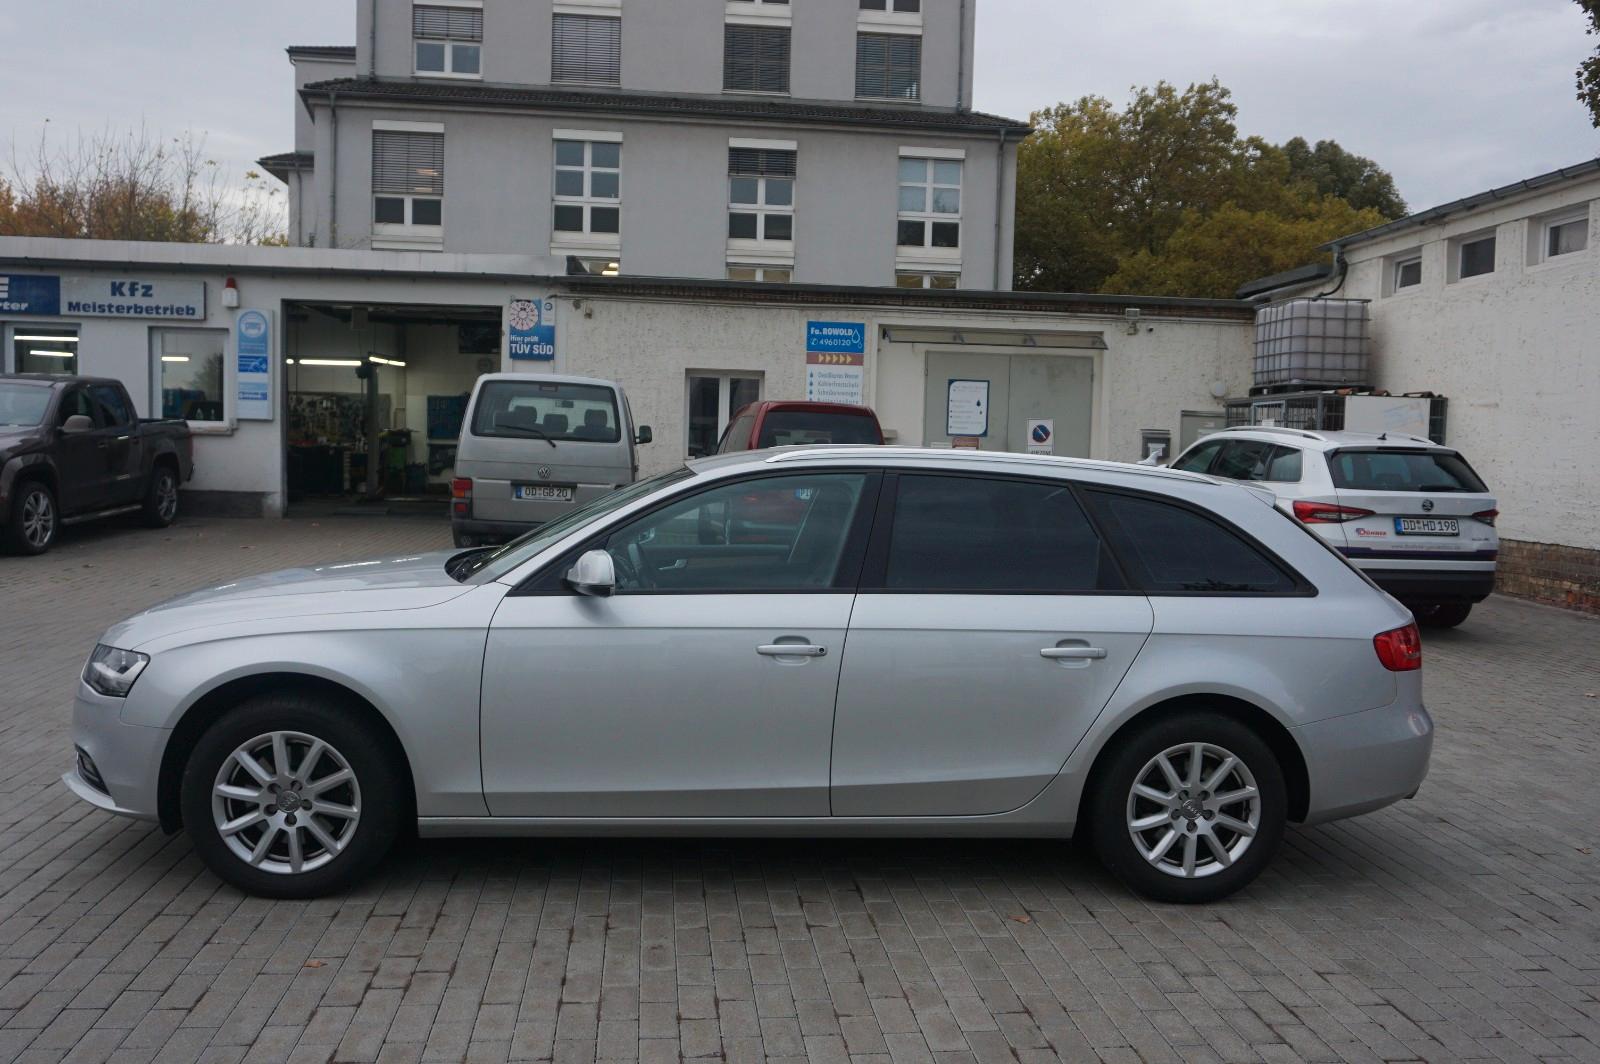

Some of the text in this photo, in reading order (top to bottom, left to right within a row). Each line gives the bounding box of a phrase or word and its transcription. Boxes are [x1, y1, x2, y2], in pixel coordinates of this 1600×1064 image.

[110, 280, 153, 298] Kfz
[0, 302, 29, 312] ter
[67, 301, 197, 316] Meisterbetrieb
[822, 328, 853, 336] ROWOLD
[511, 341, 554, 355] TÜV SÜD
[542, 487, 555, 498] GB
[556, 487, 568, 498] 20
[1402, 519, 1458, 532] DD HD 198
